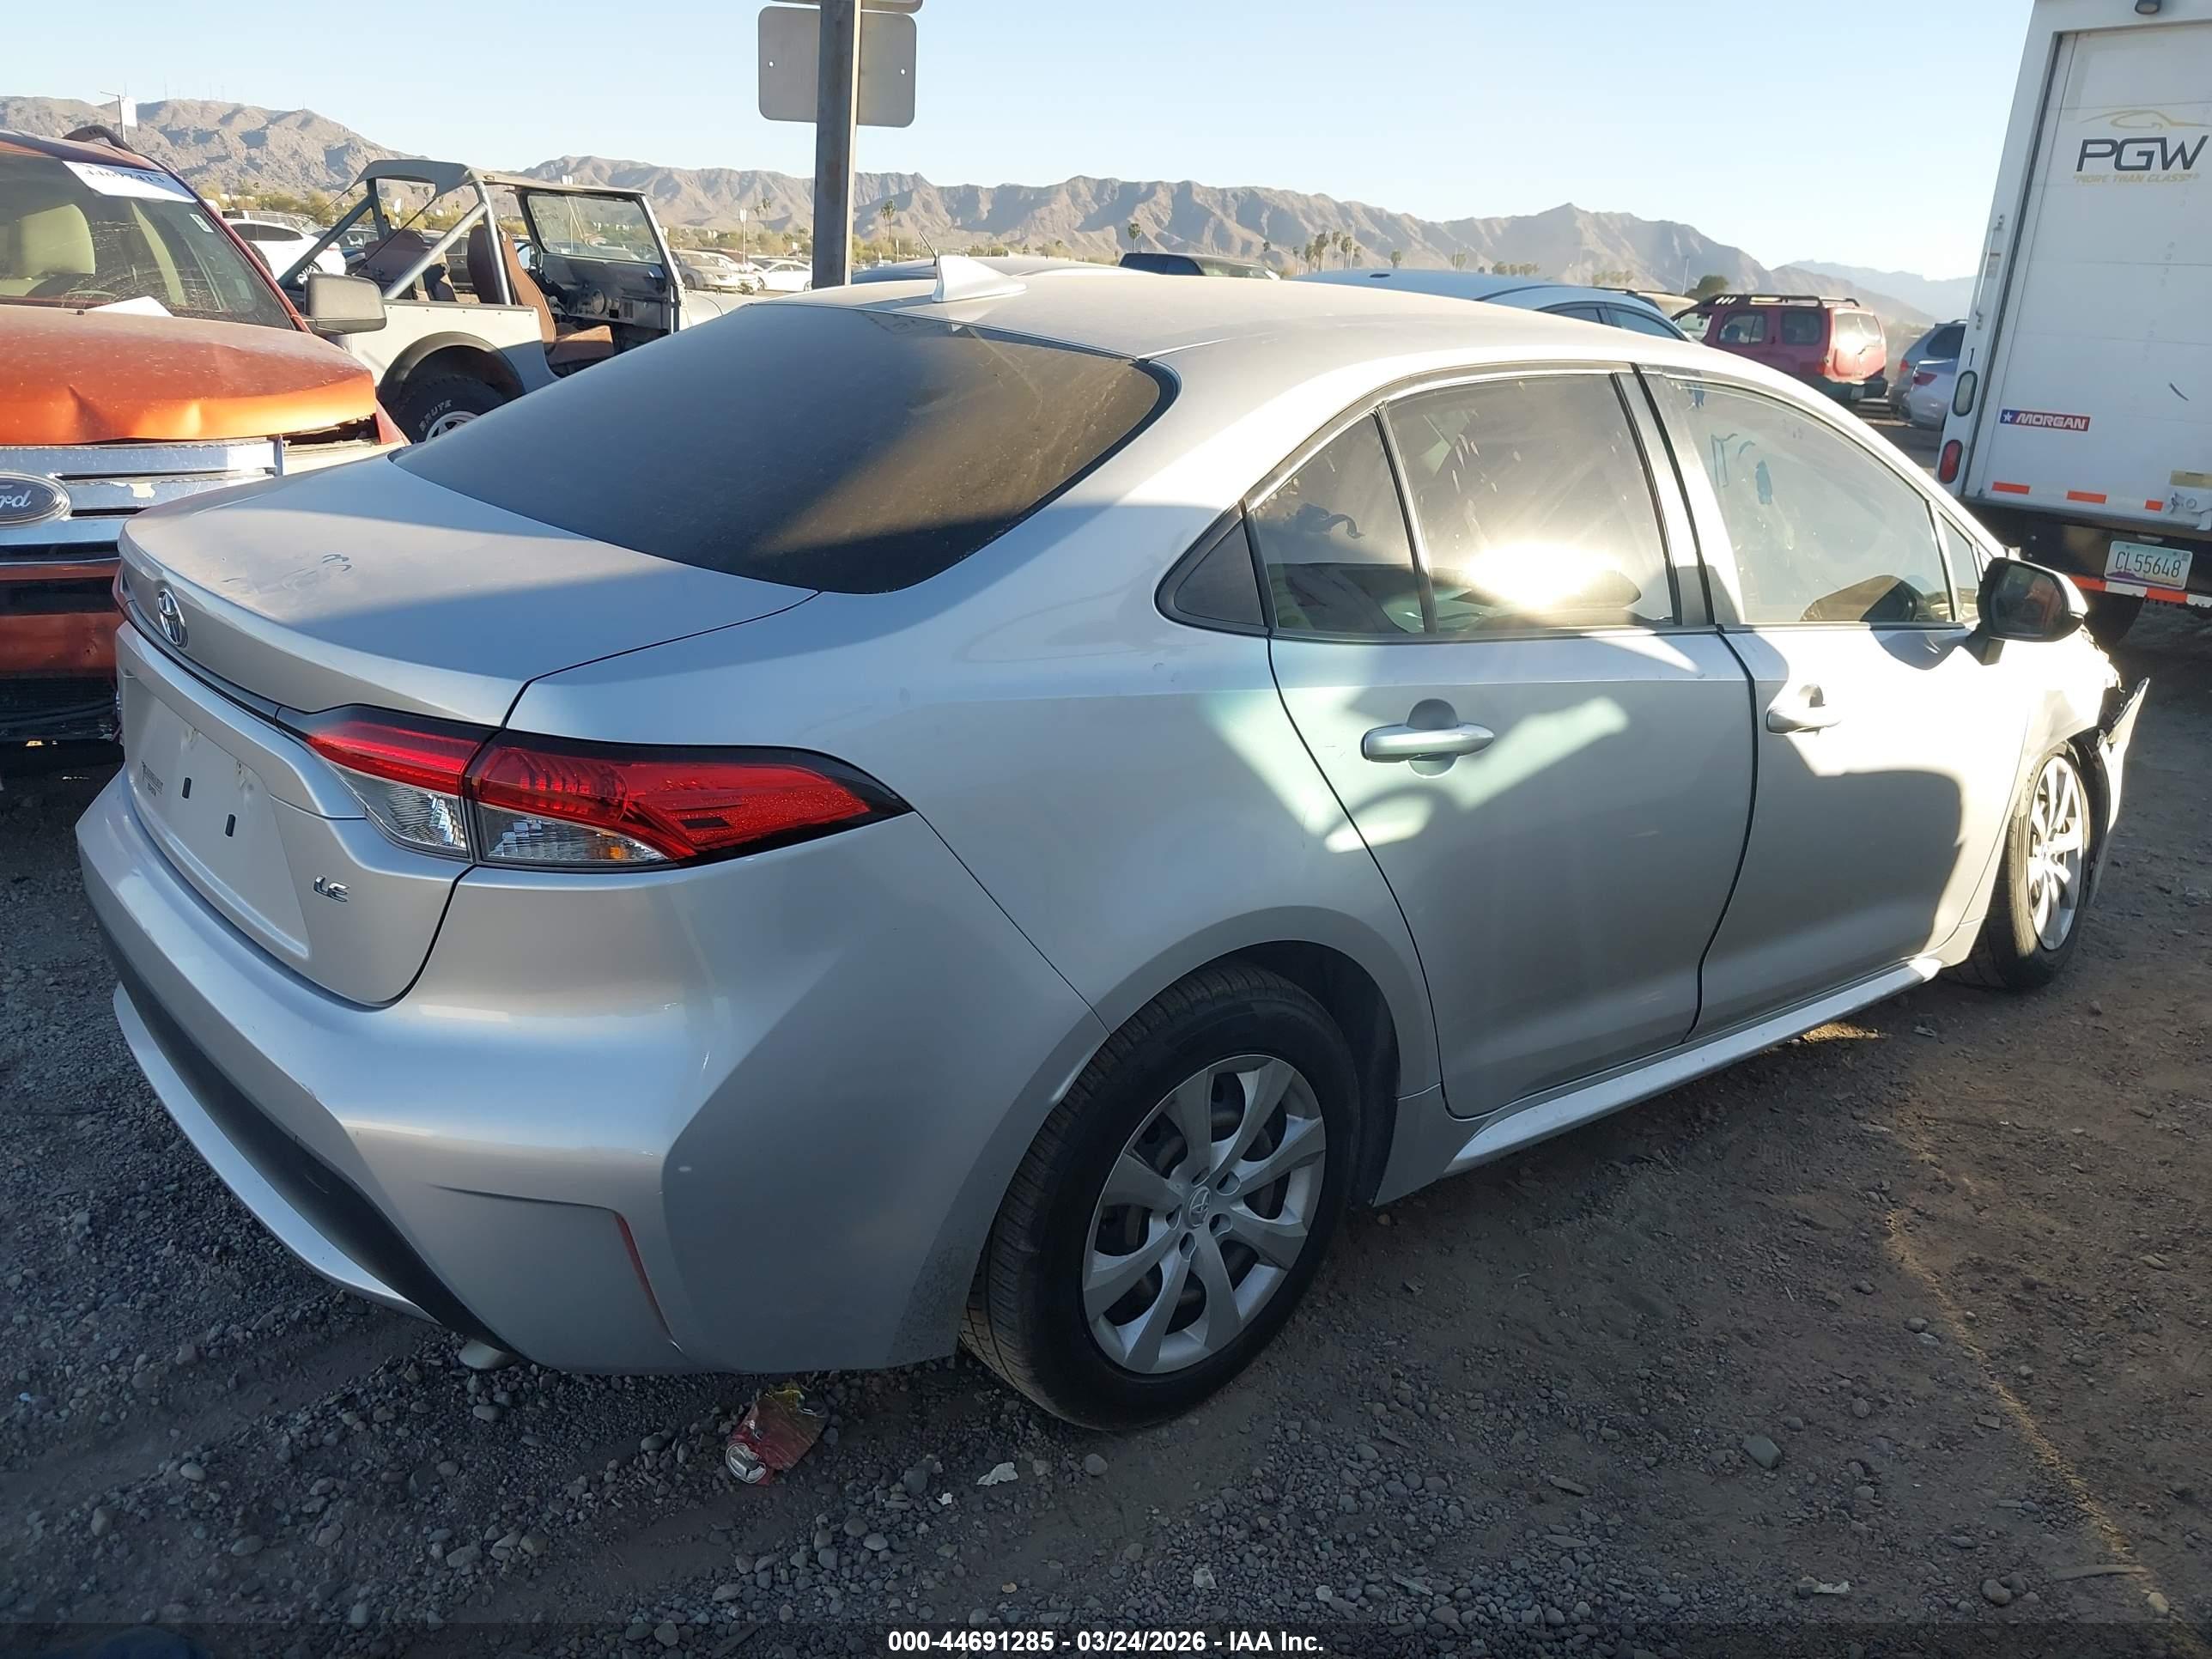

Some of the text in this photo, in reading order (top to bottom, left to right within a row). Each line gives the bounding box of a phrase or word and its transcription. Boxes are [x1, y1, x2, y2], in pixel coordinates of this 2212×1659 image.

[2076, 135, 2209, 172] PGW
[2015, 412, 2087, 429] MORGAN
[2115, 551, 2181, 578] CL55648
[313, 876, 349, 902] LE
